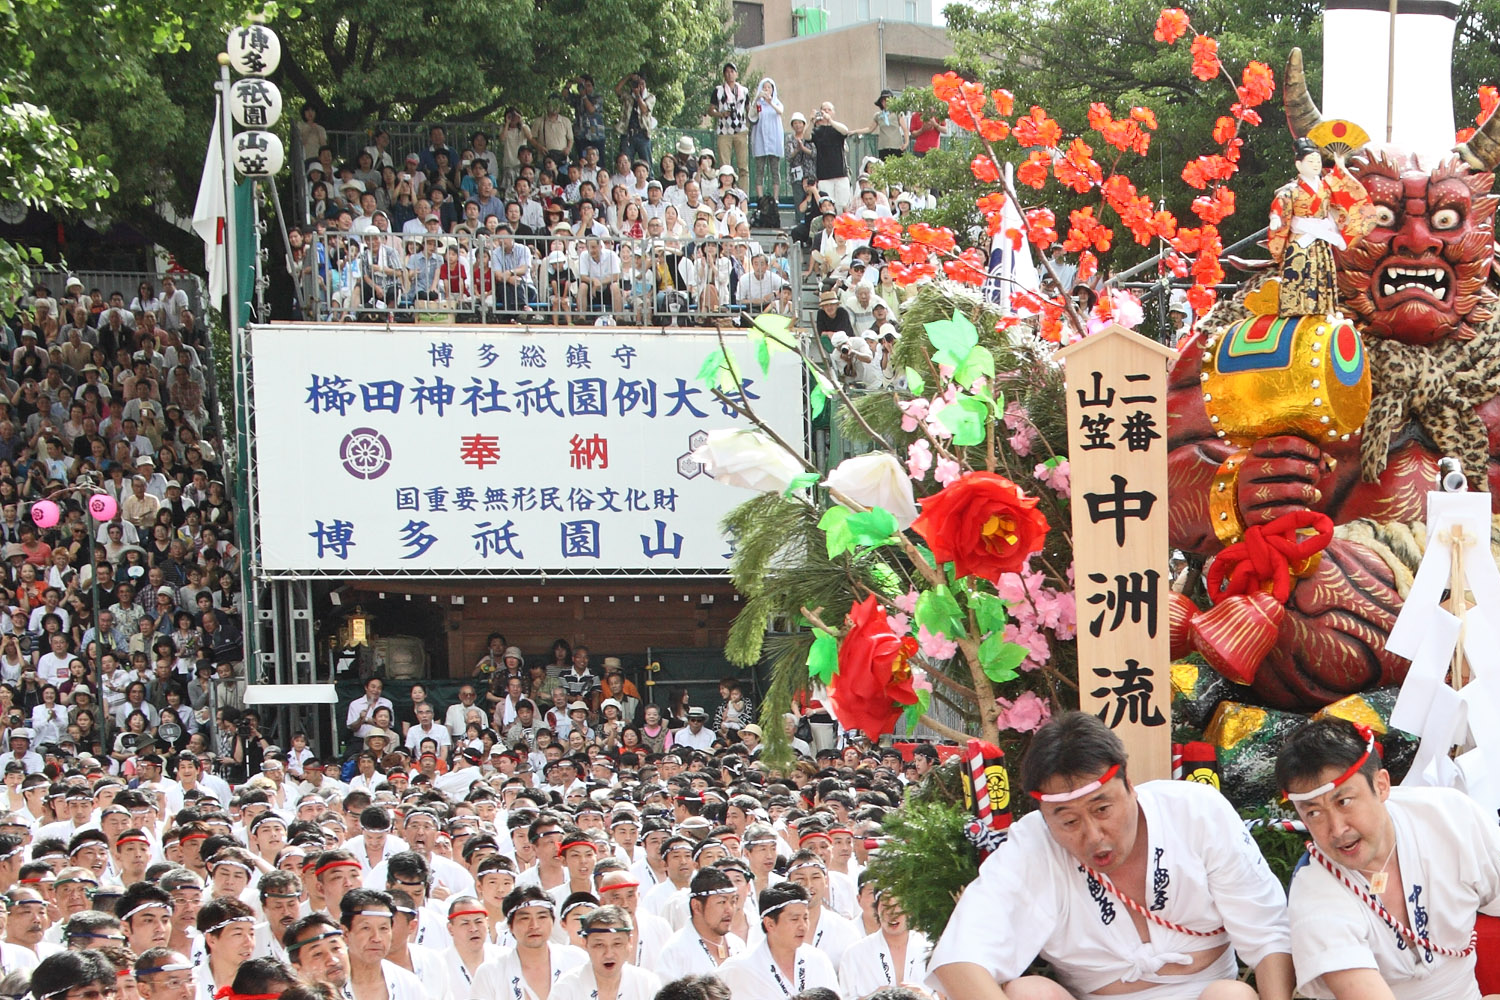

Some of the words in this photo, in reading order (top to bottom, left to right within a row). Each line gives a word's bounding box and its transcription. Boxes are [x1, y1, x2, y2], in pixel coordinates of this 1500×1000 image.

[428, 343, 637, 369] 博多総鎮守
[1076, 371, 1116, 452] 山笠
[1118, 373, 1161, 452] 二番
[461, 433, 609, 470] 奉納
[395, 486, 679, 513] 国重要無形民俗文化財
[309, 519, 738, 560] 博多祇園山
[1083, 474, 1166, 728] 中洲流
